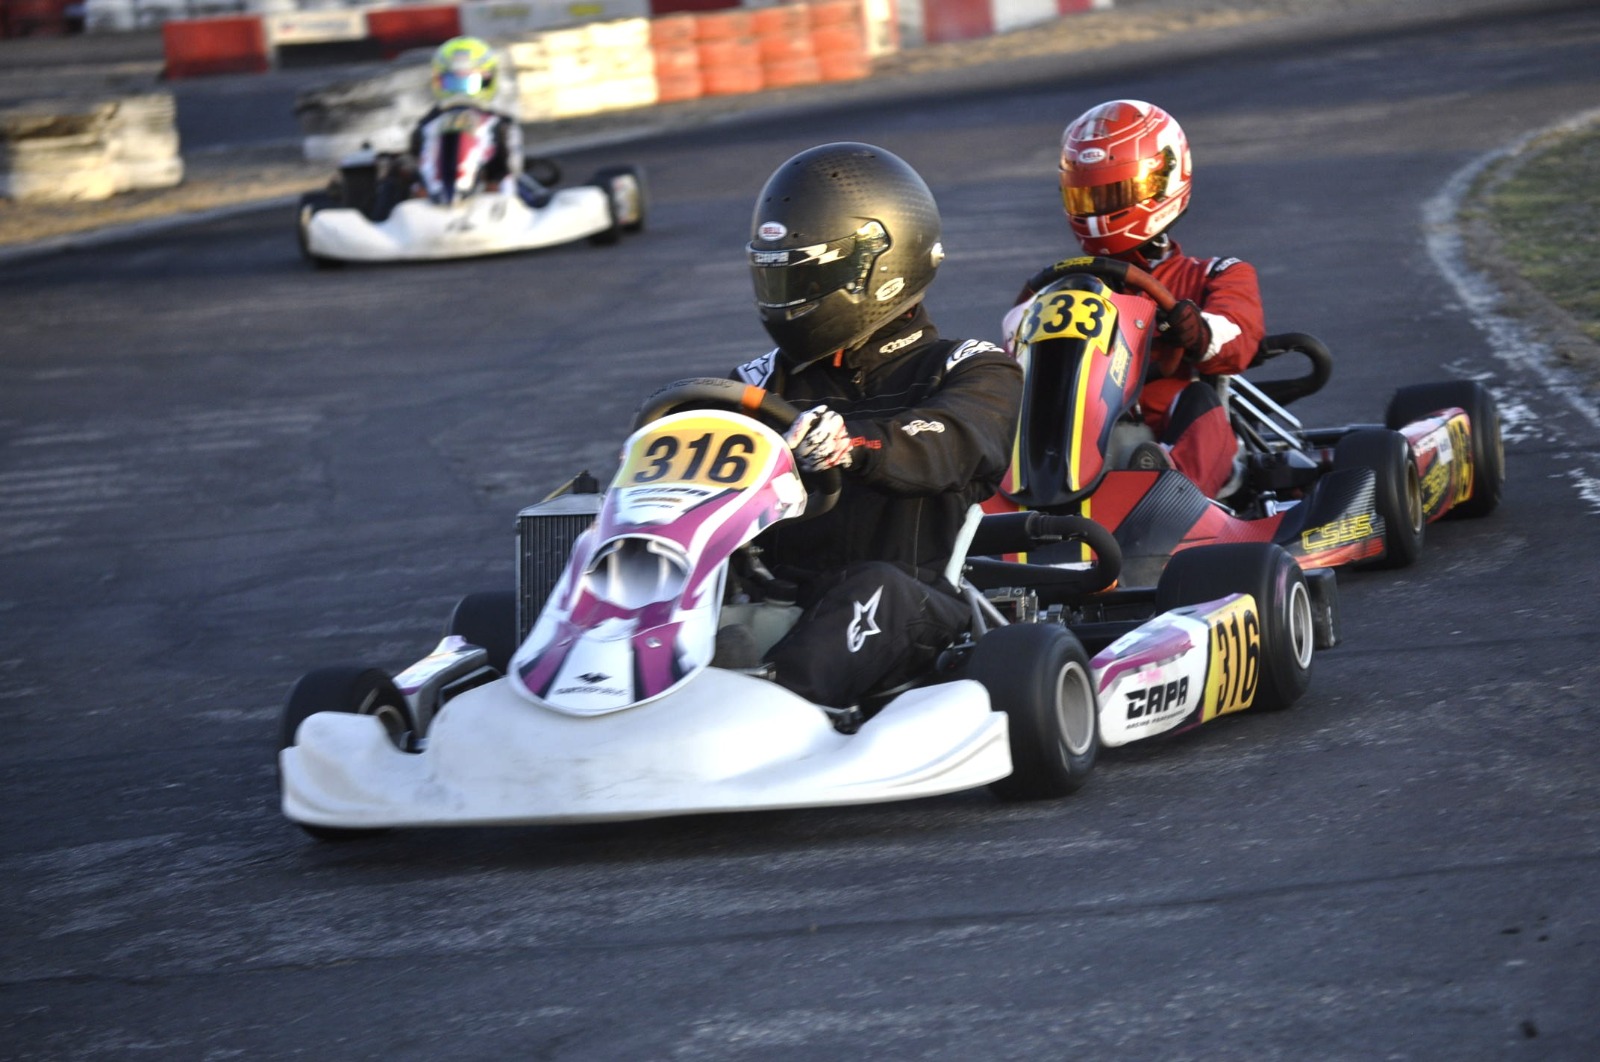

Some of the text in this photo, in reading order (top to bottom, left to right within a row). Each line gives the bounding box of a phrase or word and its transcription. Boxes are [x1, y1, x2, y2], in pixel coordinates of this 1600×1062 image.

[1020, 293, 1105, 338] 333
[634, 432, 755, 484] 316
[1216, 609, 1260, 715] 316
[1125, 675, 1189, 720] CAPA
